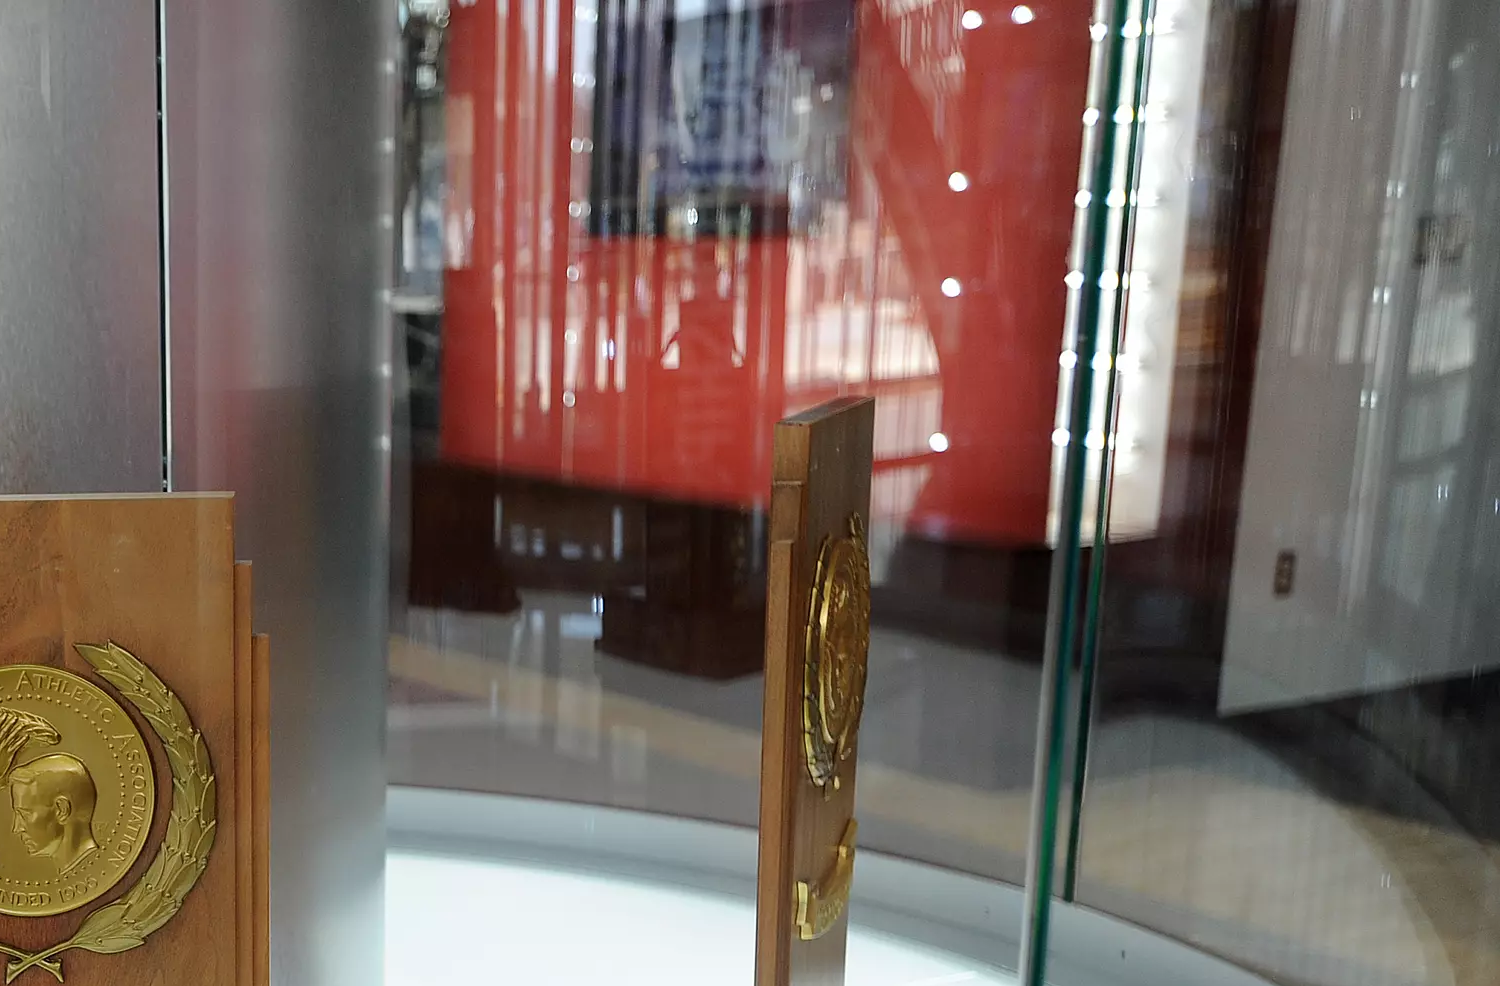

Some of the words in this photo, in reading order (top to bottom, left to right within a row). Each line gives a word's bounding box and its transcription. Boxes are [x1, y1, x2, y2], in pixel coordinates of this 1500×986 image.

[16, 670, 116, 724] ATHLETIC
[111, 733, 147, 870] ASSOCIATION
[58, 876, 100, 905] 1906
